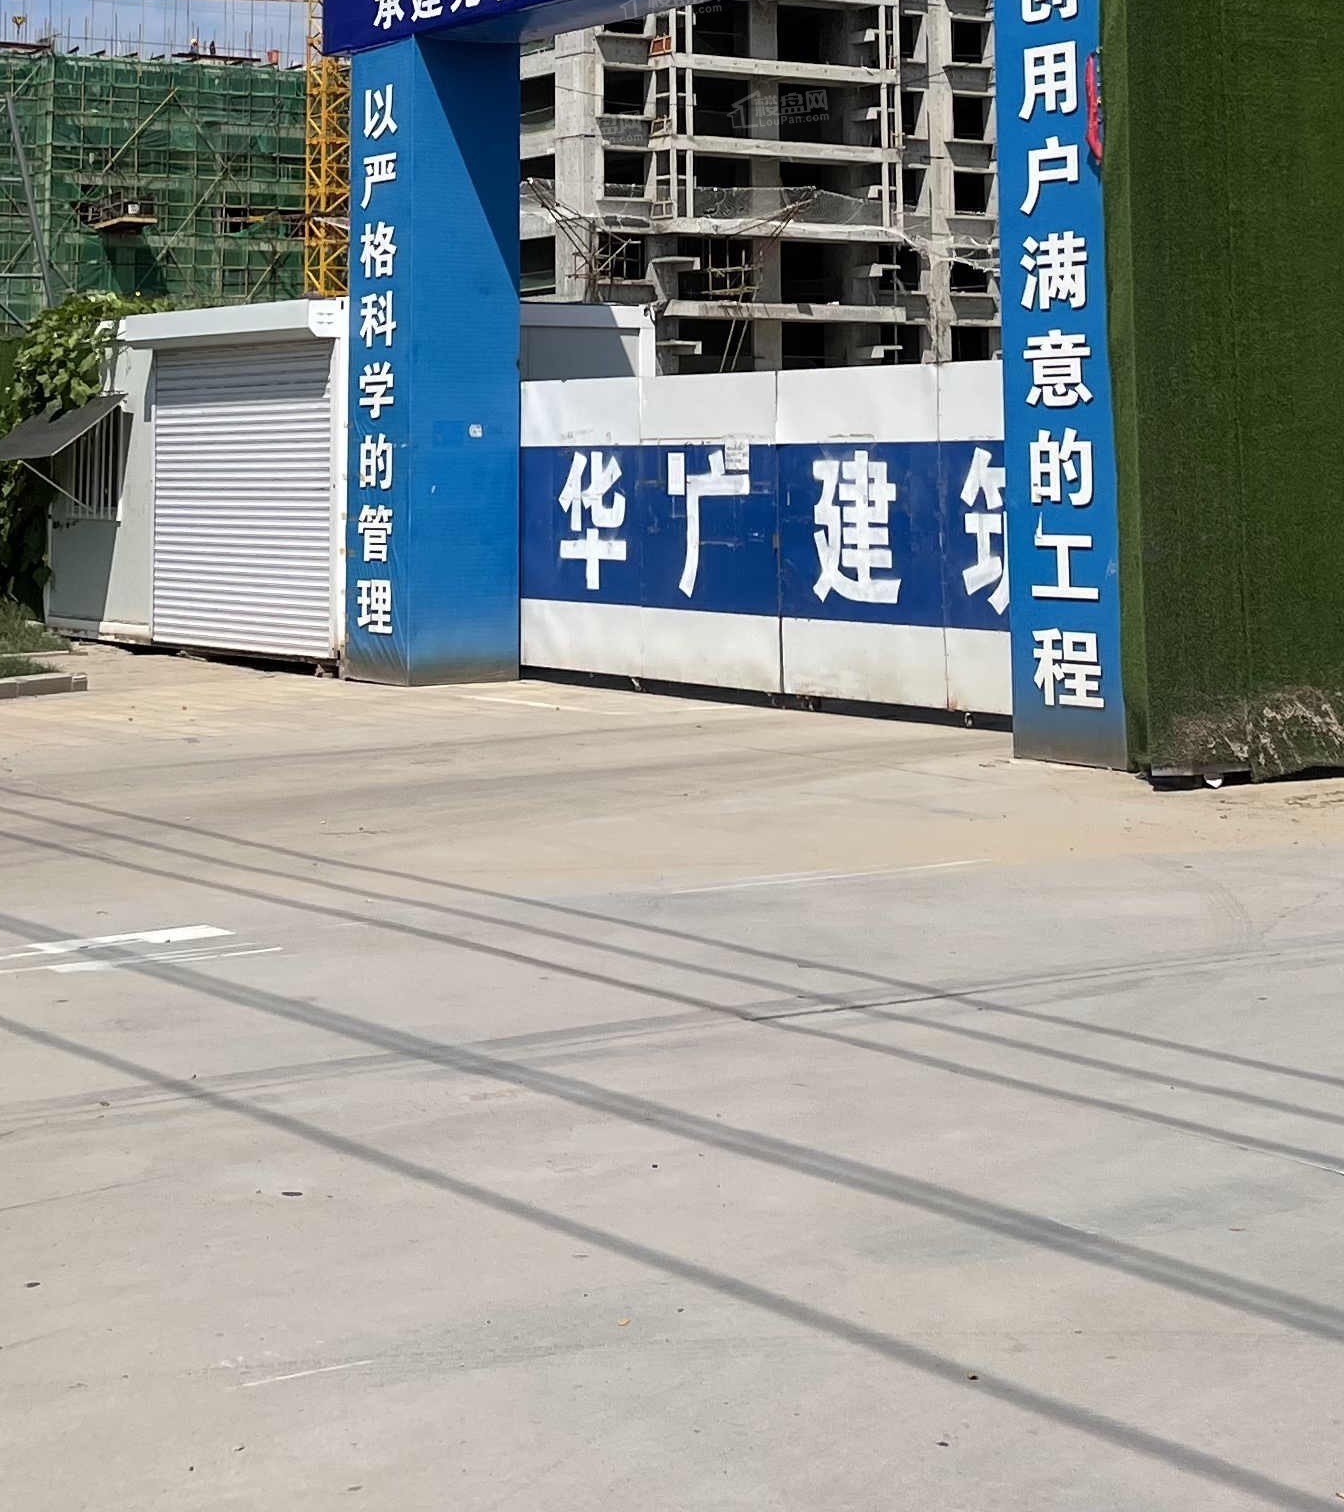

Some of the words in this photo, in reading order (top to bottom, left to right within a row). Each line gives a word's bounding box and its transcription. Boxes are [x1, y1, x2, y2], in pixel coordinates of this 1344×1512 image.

[358, 85, 398, 635] 以严格科学的管理
